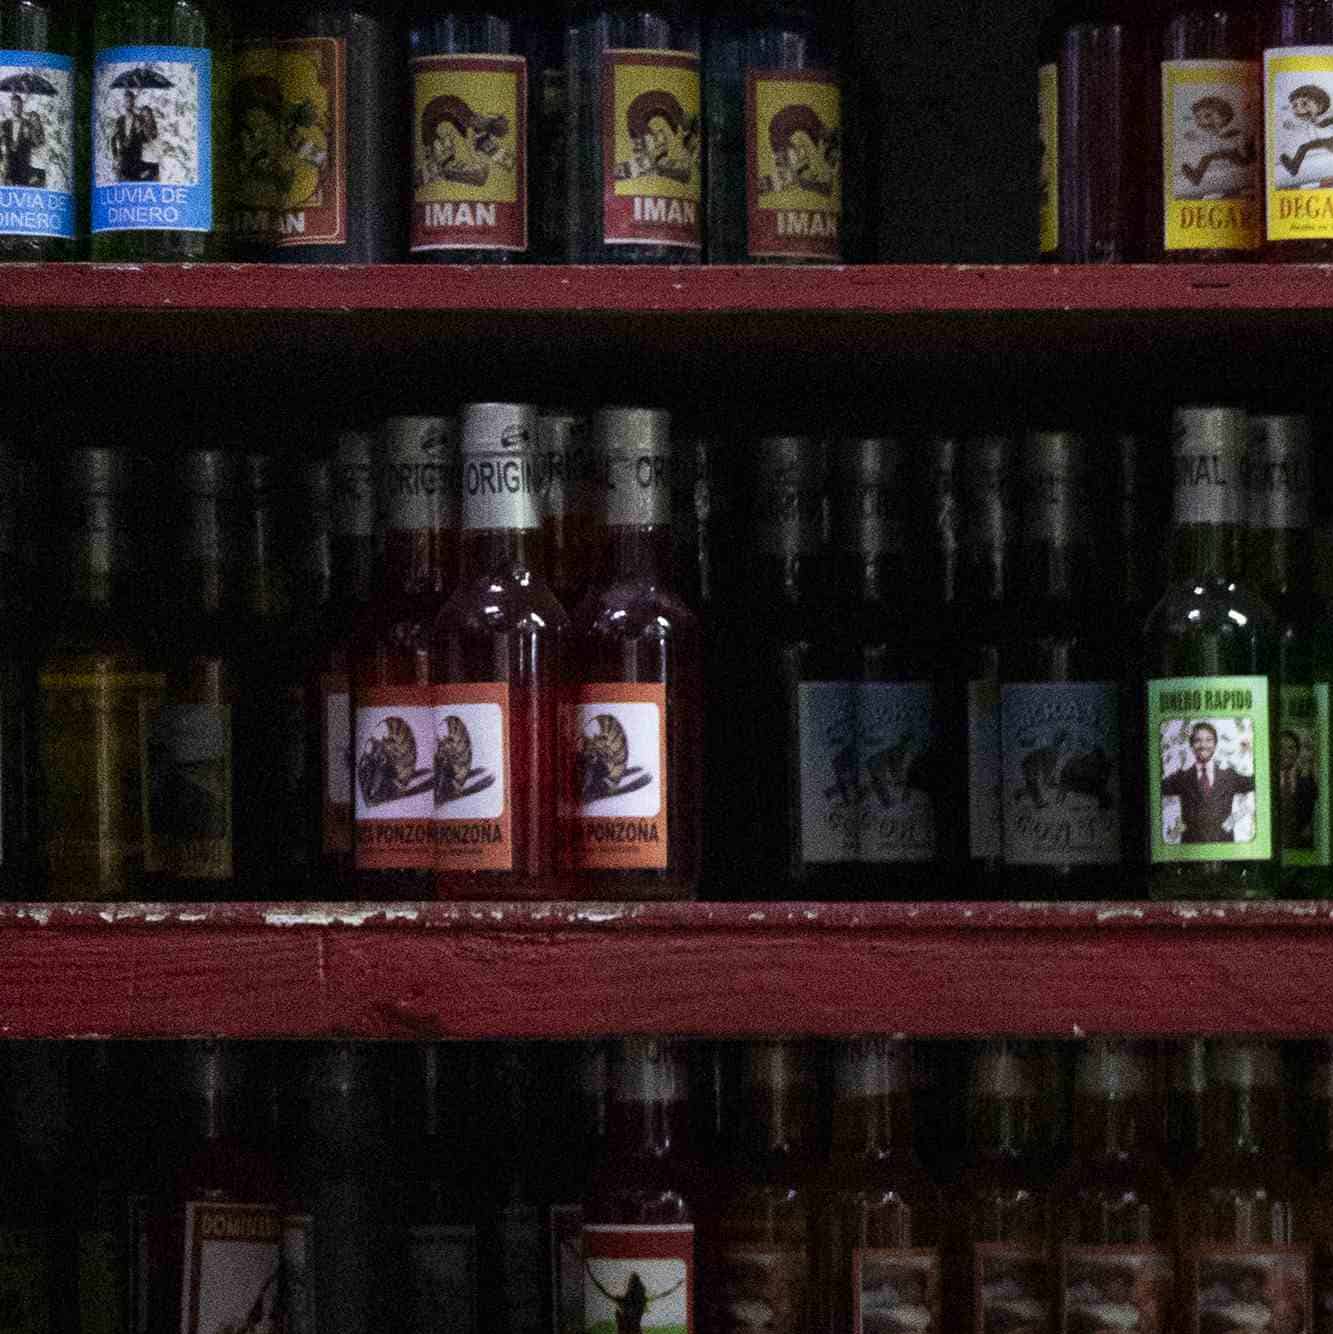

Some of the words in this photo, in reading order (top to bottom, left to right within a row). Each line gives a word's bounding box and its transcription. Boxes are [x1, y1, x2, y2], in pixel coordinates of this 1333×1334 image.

[100, 189, 167, 206] LLUVIA
[167, 188, 188, 204] DE
[107, 206, 179, 224] DINERO
[424, 202, 497, 227] IMAN
[633, 196, 696, 224] IMAN
[1204, 689, 1254, 712] RAPIDO
